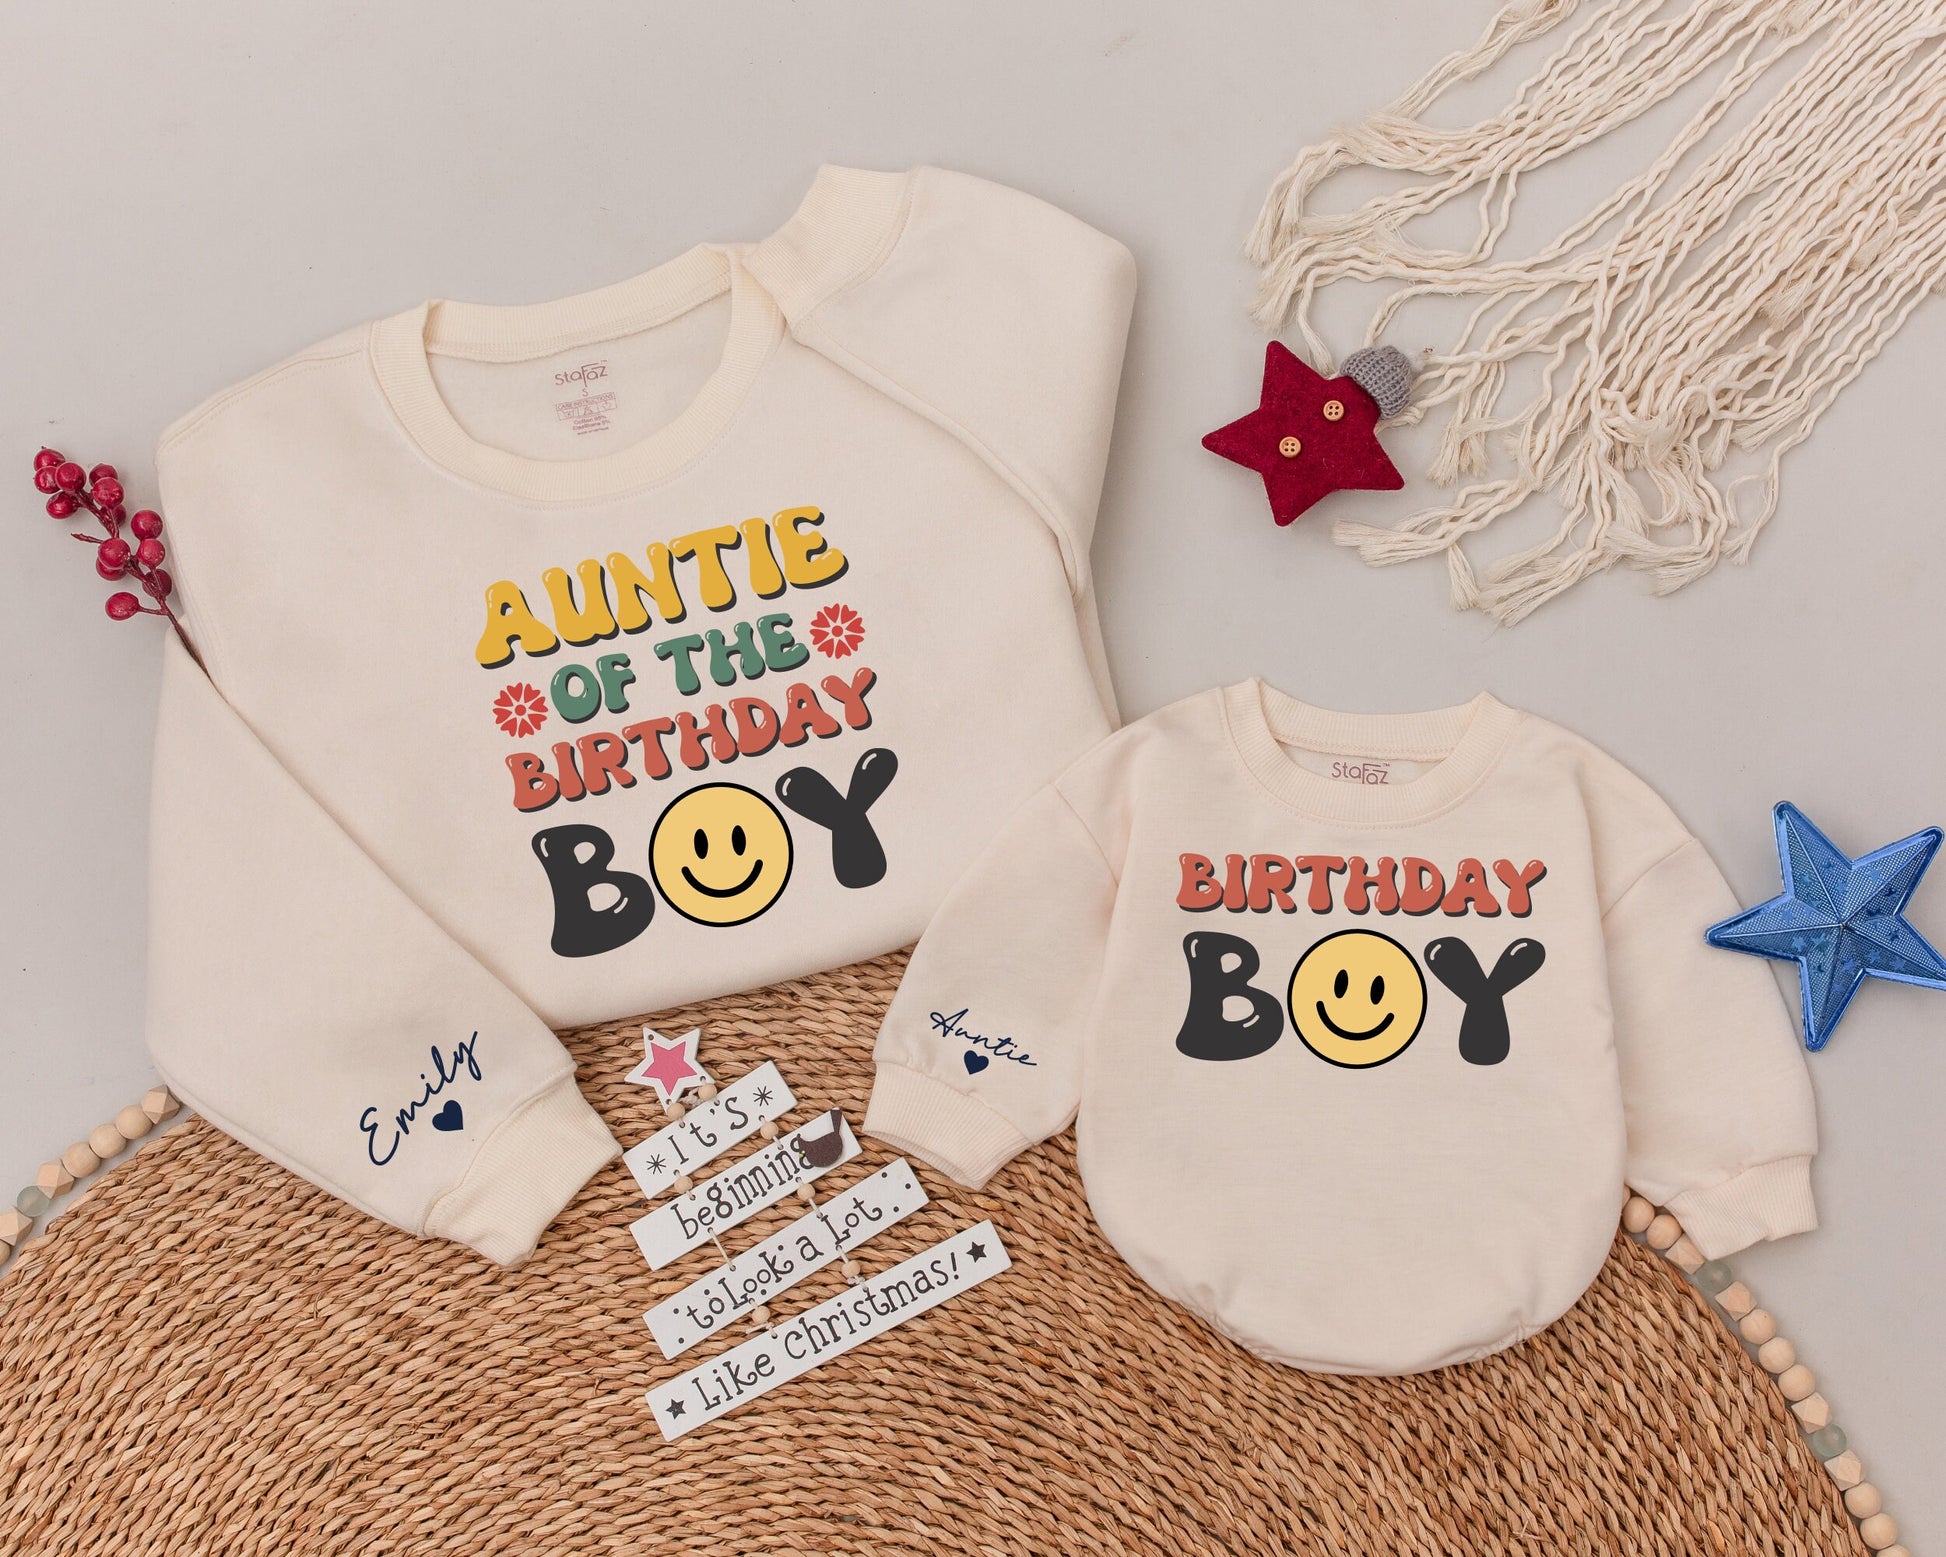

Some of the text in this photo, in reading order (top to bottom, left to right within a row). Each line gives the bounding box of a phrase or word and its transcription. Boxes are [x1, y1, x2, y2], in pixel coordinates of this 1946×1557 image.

[582, 388, 589, 397] S
[475, 506, 849, 670] AUNTIE
[550, 613, 810, 724] OF THE
[505, 667, 877, 812] BIRTHDAY
[1175, 853, 1547, 918] BIRTHDAY
[930, 1008, 1037, 1067] Auntie
[360, 1031, 482, 1166] Emily
[796, 1235, 824, 1262] a
[691, 1352, 776, 1411] Like
